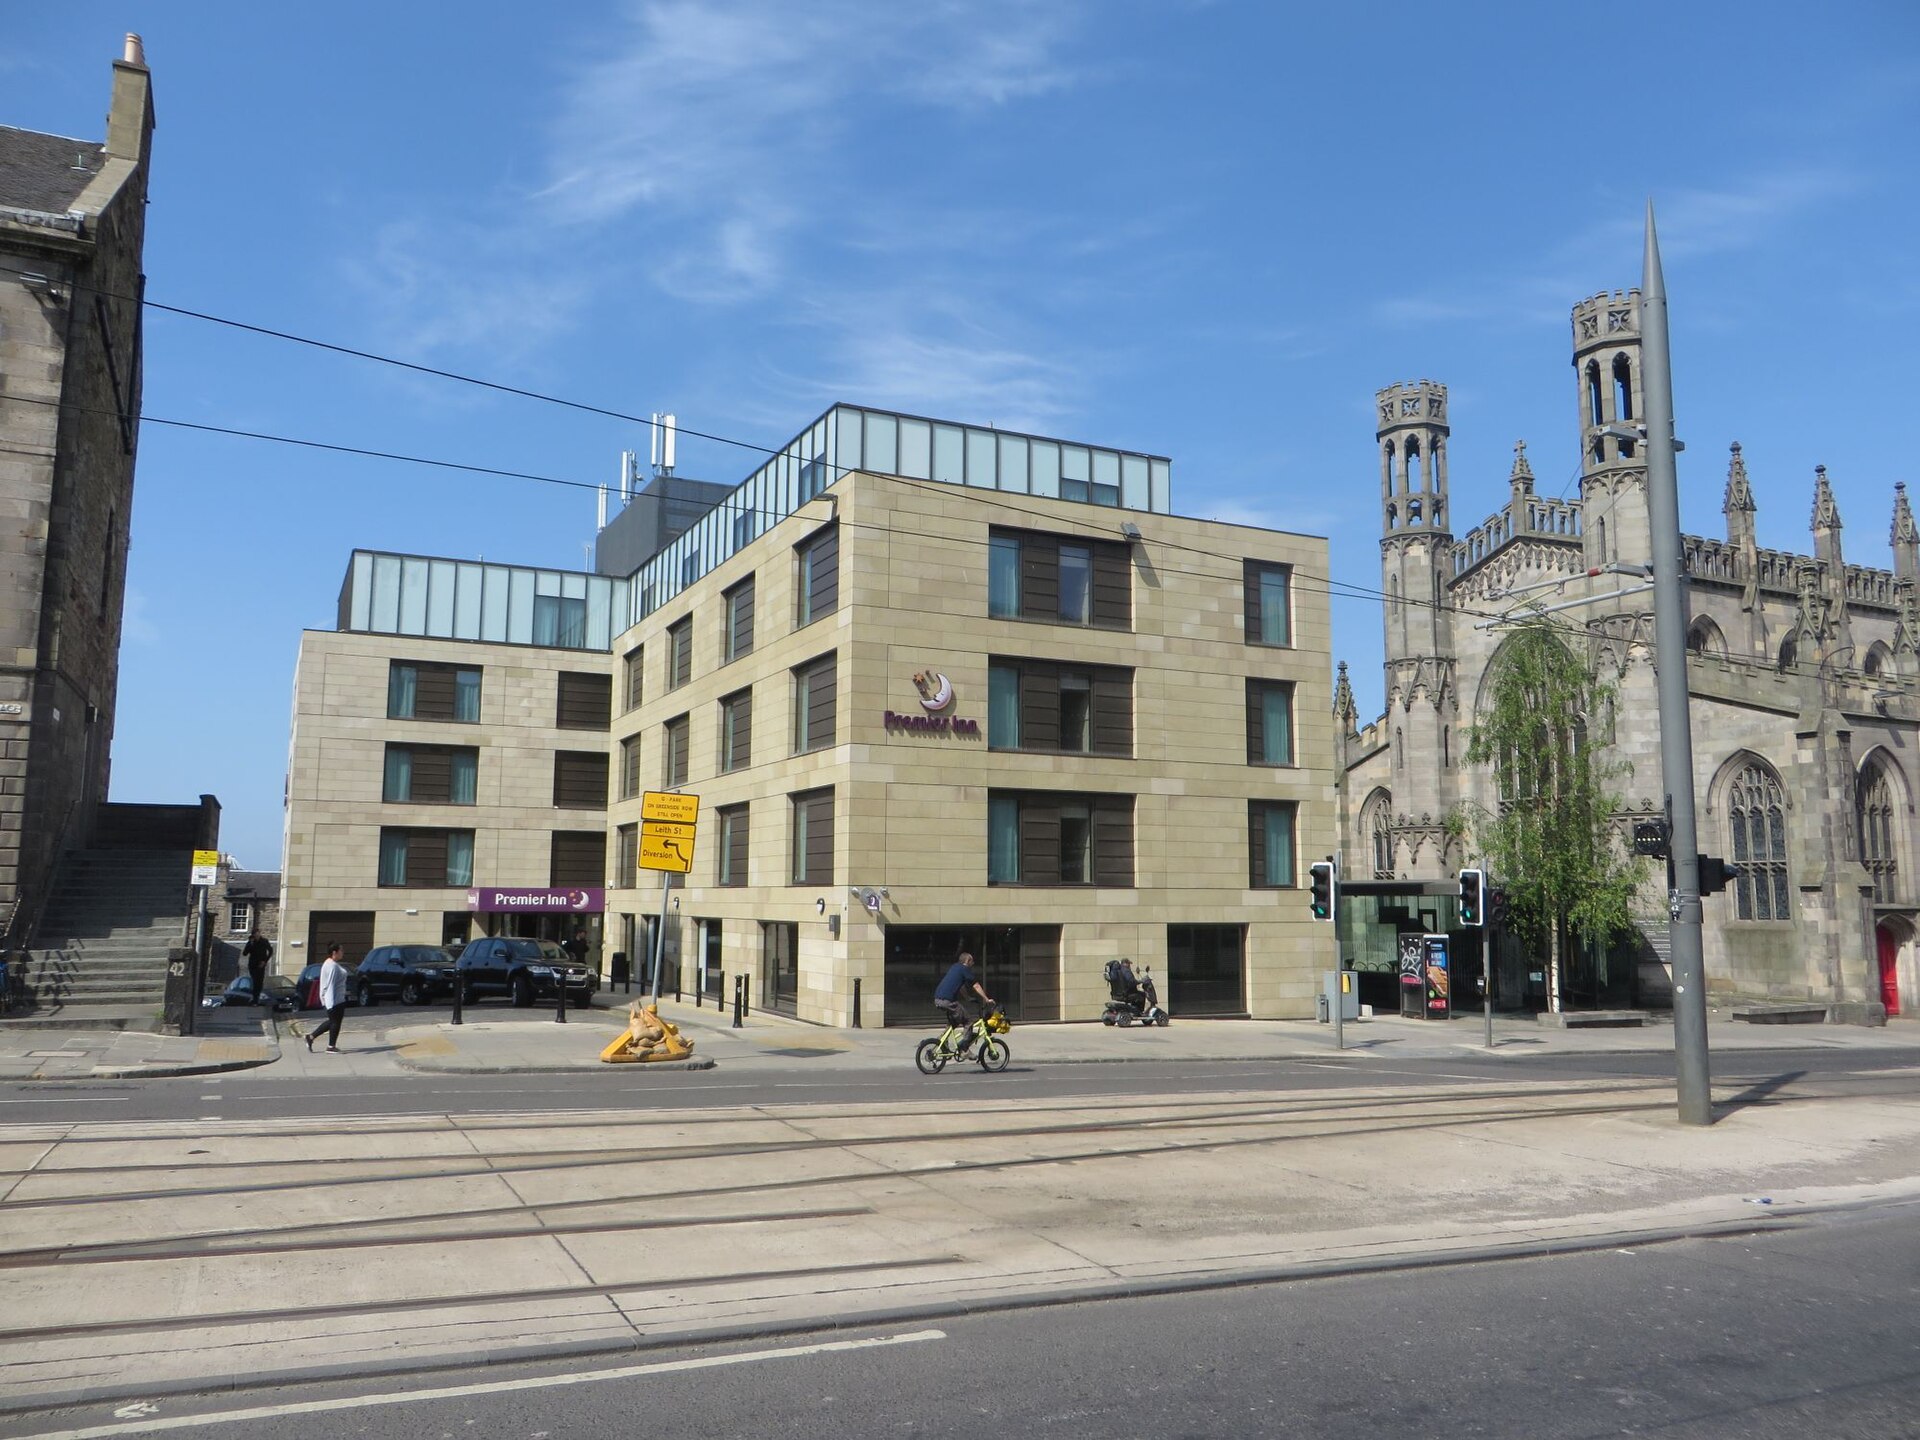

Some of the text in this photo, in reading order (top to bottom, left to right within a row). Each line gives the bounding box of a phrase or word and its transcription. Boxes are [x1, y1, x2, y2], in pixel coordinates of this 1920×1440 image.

[884, 711, 978, 734] Premier Inn
[655, 826, 682, 835] Leith St
[642, 849, 673, 860] Diversion
[494, 893, 546, 906] Premier
[547, 893, 567, 906] Inn
[169, 961, 185, 977] 42
